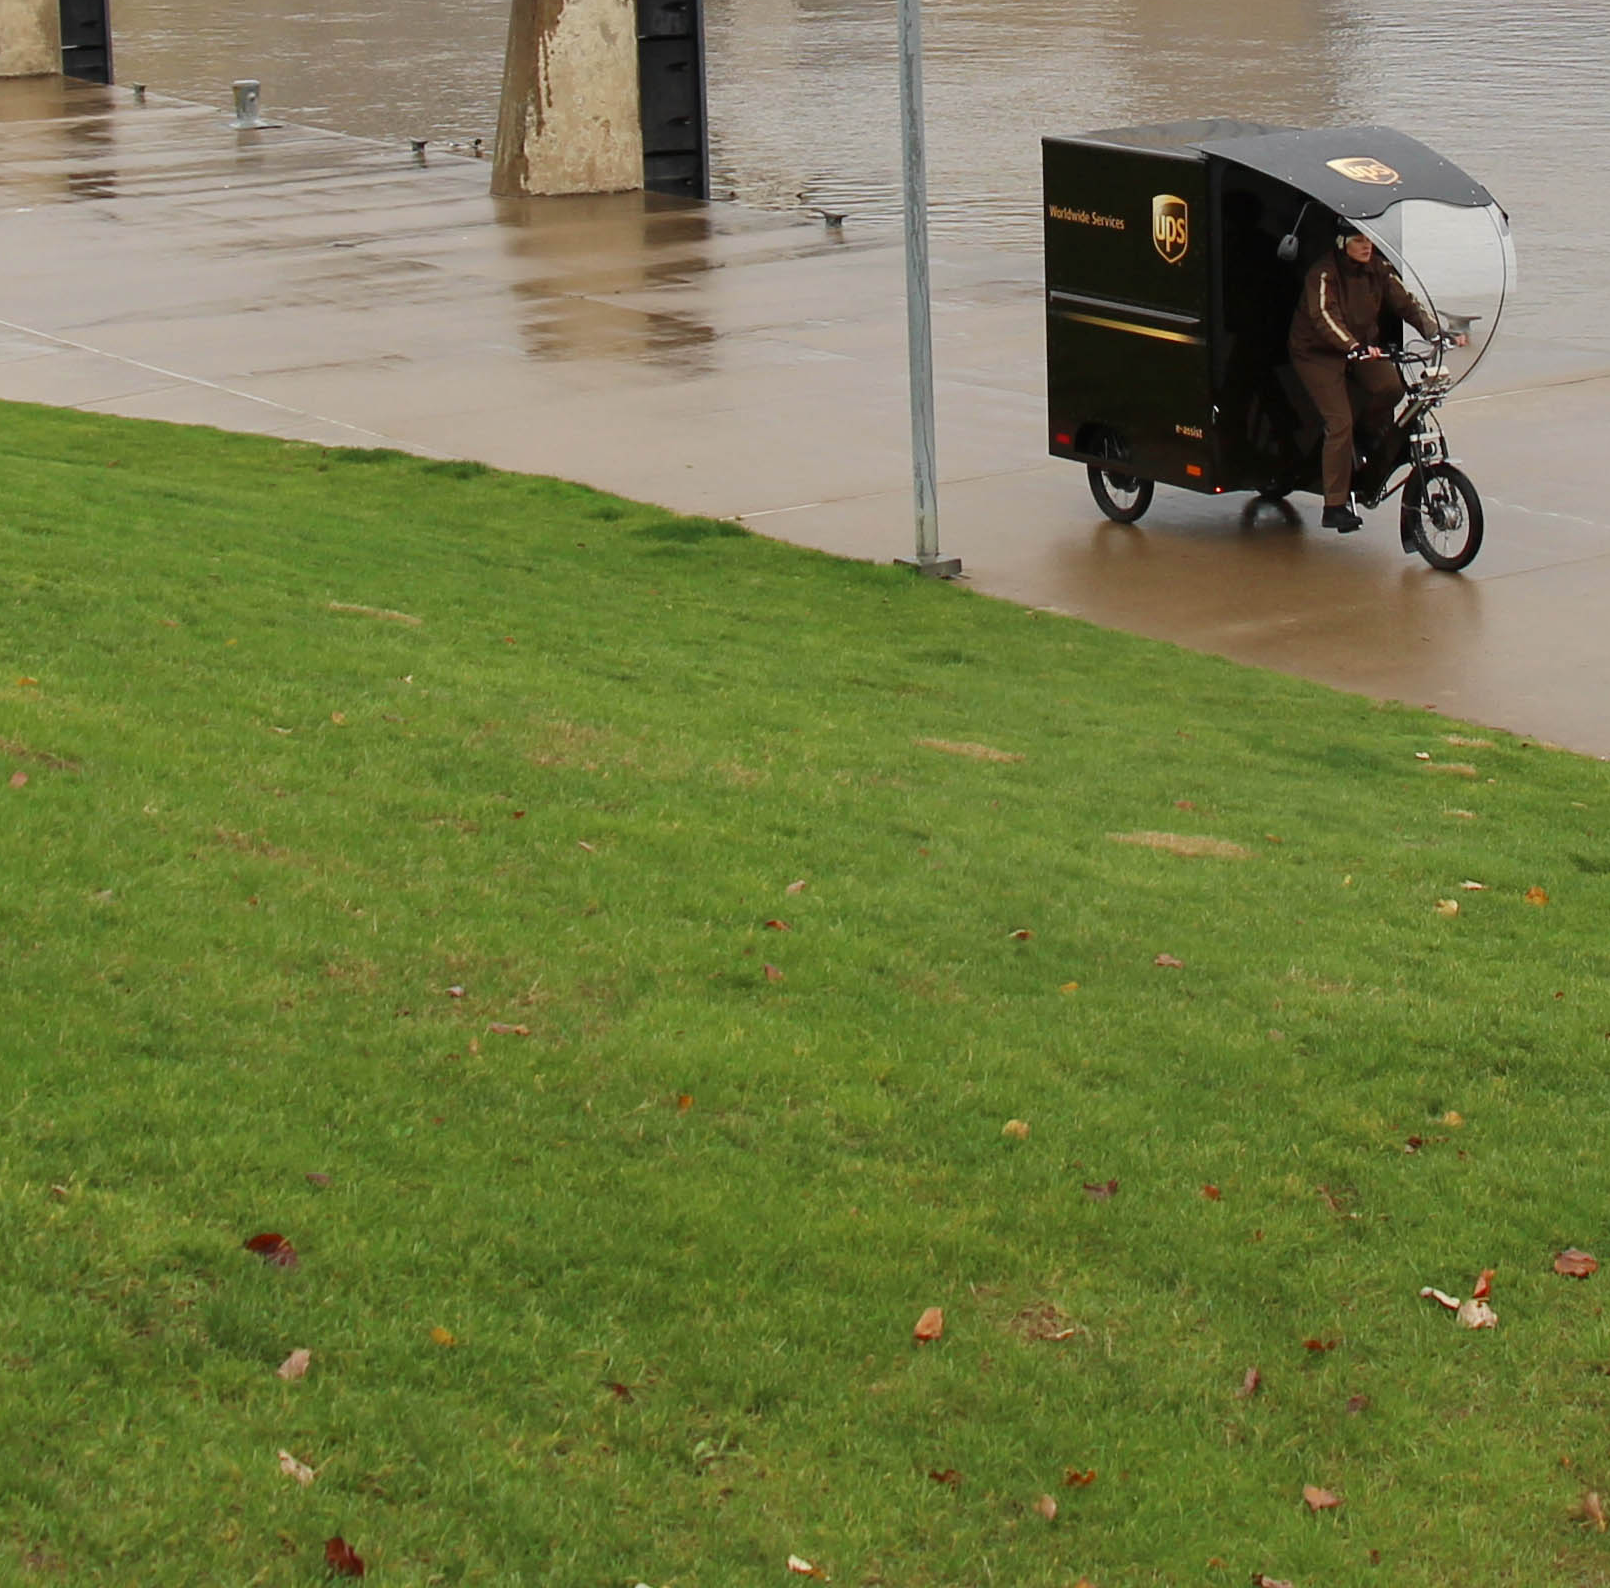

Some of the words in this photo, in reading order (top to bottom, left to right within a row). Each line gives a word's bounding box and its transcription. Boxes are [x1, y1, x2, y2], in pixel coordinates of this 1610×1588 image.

[1348, 164, 1392, 181] ups
[1048, 203, 1090, 224] Worldwide
[1091, 211, 1126, 230] Services
[1155, 214, 1186, 253] ups
